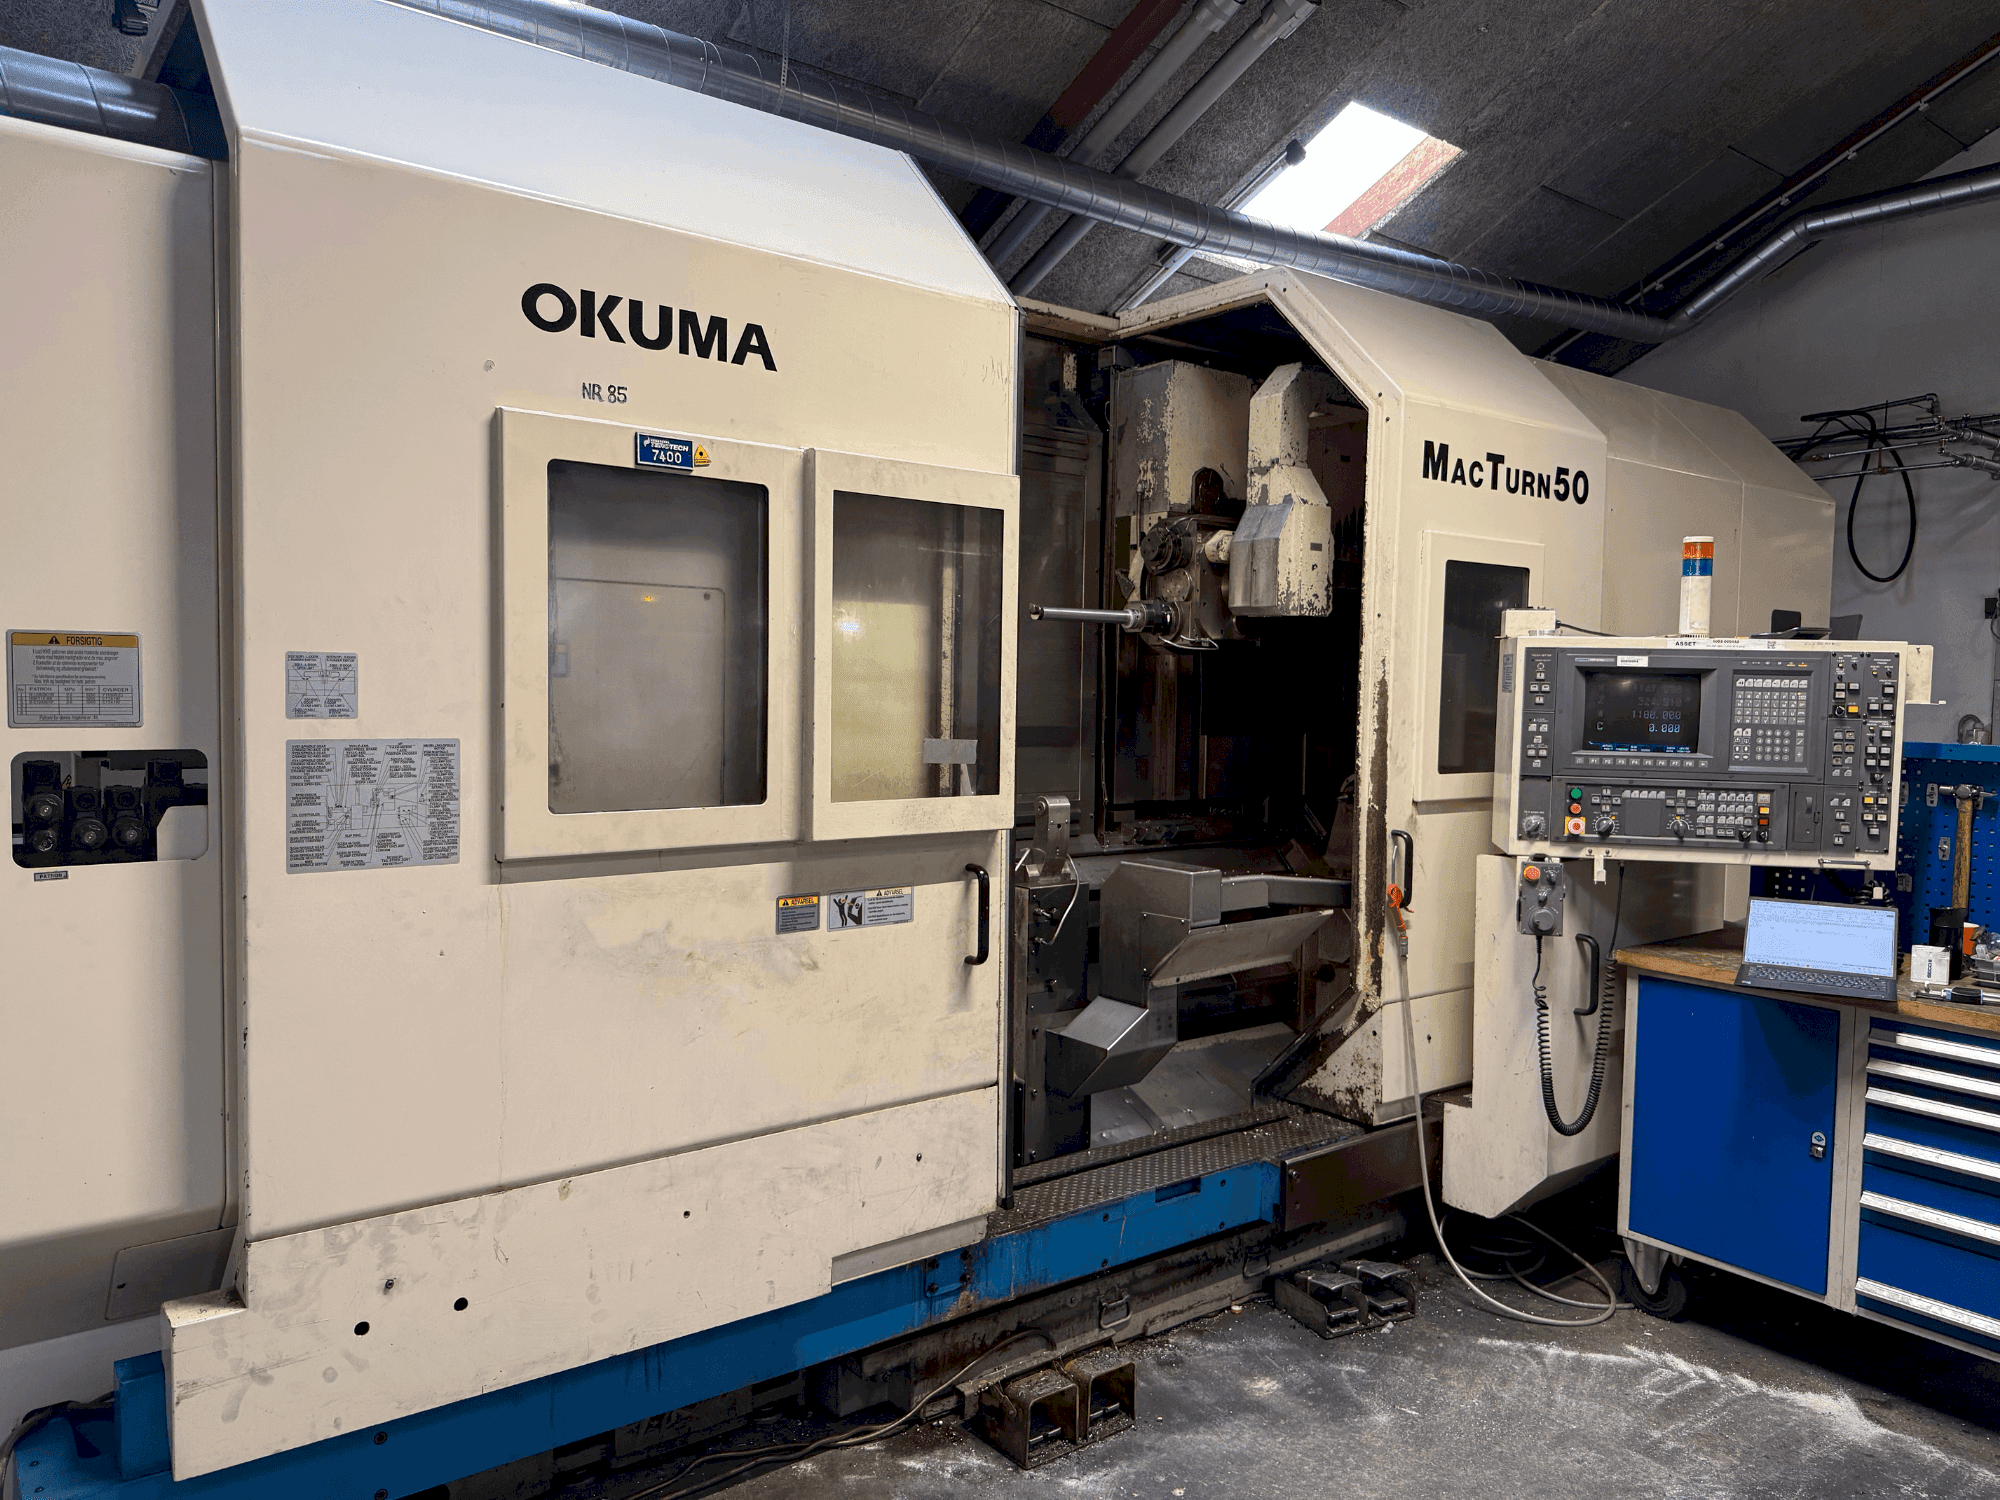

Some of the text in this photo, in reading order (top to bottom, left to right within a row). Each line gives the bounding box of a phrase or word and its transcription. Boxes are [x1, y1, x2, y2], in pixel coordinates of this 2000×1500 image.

[521, 283, 778, 373] OKUMA
[607, 385, 628, 404] 85
[651, 449, 682, 464] 7400
[66, 636, 103, 646] FORSIGTIG
[1596, 721, 1681, 733] C 0.000
